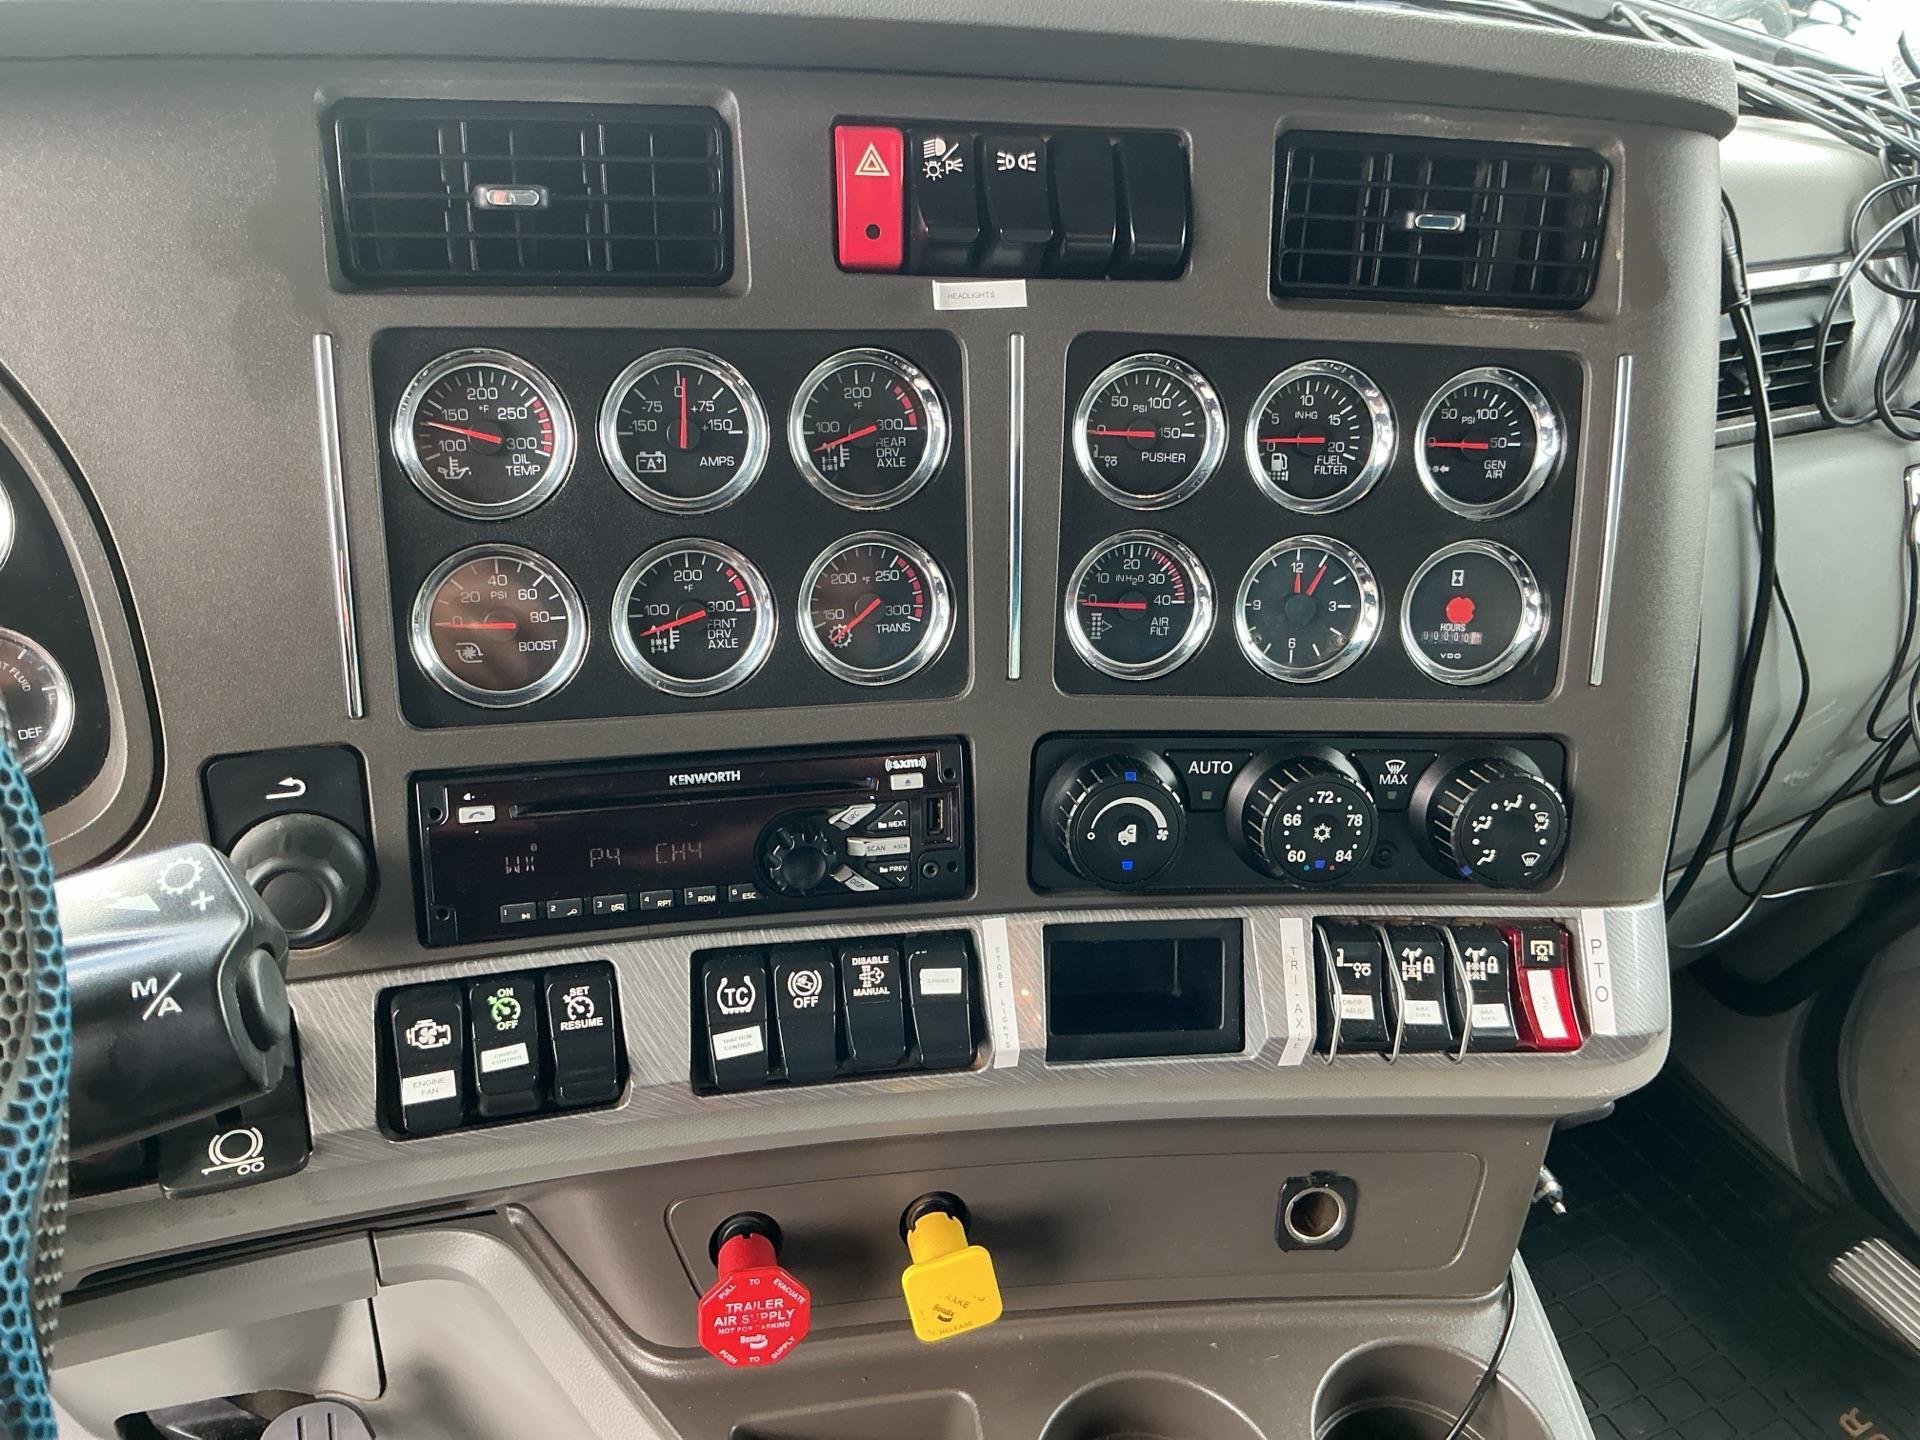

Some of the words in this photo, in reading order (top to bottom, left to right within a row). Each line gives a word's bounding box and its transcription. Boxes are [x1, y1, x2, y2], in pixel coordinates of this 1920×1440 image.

[948, 291, 995, 299] HEADLIGHTS
[467, 387, 498, 400] 200
[844, 387, 872, 399] 200
[1111, 396, 1129, 408] 50
[1148, 397, 1172, 409] 100
[1300, 394, 1314, 407] 10
[690, 400, 715, 413] +75
[1132, 404, 1148, 413] PSI
[442, 408, 469, 421] 150
[498, 407, 527, 420] 250
[1441, 409, 1457, 420] 50
[1476, 409, 1498, 420] 100
[702, 419, 733, 431] +150
[877, 418, 903, 431] 300
[1271, 414, 1280, 425] 5
[1328, 415, 1341, 426] 15
[1461, 416, 1476, 424] PSI
[816, 421, 840, 433] 100
[1160, 427, 1181, 439] 150
[439, 439, 466, 452] 100
[507, 437, 537, 450] 300
[876, 437, 906, 447] REAR
[1266, 441, 1276, 452] 0
[1328, 442, 1345, 453] 20
[1427, 437, 1437, 448] 0
[876, 448, 899, 459] DRV
[1141, 451, 1186, 463] PUSHER
[512, 454, 531, 465] OIL
[700, 456, 735, 467] AMPS
[877, 458, 907, 468] AXLE
[1316, 455, 1343, 465] FUEL
[1484, 460, 1506, 470] GEN
[505, 465, 541, 476] TEMP
[1313, 465, 1348, 475] FILTER
[1485, 469, 1503, 479] AIR
[1123, 559, 1140, 570] 20
[1291, 562, 1304, 573] 12
[488, 574, 508, 587] 40
[673, 569, 703, 582] 200
[830, 572, 857, 584] 200
[875, 570, 899, 582] 250
[1096, 573, 1109, 584] 10
[1148, 574, 1165, 585] 30
[460, 591, 481, 603] 20
[490, 591, 507, 600] PSI
[518, 588, 538, 601] 60
[1088, 593, 1097, 604] 0
[1153, 595, 1171, 606] 40
[1252, 600, 1262, 610] 9
[644, 604, 670, 616] 100
[707, 600, 736, 613] 300
[885, 604, 911, 616] 300
[1328, 601, 1337, 612] 3
[530, 611, 550, 623] 80
[824, 608, 845, 620] 150
[707, 618, 738, 629] FRNT
[876, 622, 911, 633] TRANS
[1150, 617, 1169, 627] AIR
[1440, 623, 1466, 632] HOURS
[707, 629, 732, 640] DRV
[1150, 627, 1170, 636] FILT
[518, 640, 558, 652] BOOST
[708, 638, 739, 649] AXLE
[1288, 638, 1296, 649] 6
[9, 667, 31, 692] FLUID
[18, 727, 43, 740] DEF
[1188, 761, 1233, 775] AUTO
[669, 770, 741, 786] KENWORTH
[1379, 774, 1408, 785] MAX
[1317, 791, 1334, 804] 72
[888, 820, 907, 828] NEXT
[1283, 814, 1302, 827] 66
[1346, 815, 1363, 827] 78
[867, 844, 886, 852] SCAN
[590, 848, 621, 868] P4
[656, 842, 702, 864] CH4
[1287, 850, 1306, 863] 60
[1335, 850, 1352, 862] 84
[697, 895, 716, 903] RDM
[742, 892, 757, 900] ESC
[657, 899, 673, 908] RPT
[851, 955, 890, 966] DISABLE
[497, 987, 514, 997] ON
[569, 986, 589, 996] SET
[853, 986, 891, 997] MANUAL
[724, 988, 749, 1006] TC
[793, 996, 819, 1009] OFF
[497, 1020, 518, 1031] OFF
[560, 1016, 604, 1031] RESUME
[722, 1034, 752, 1044] TRACTION
[724, 1041, 753, 1051] CONTROL
[412, 1077, 447, 1089] ENGINE
[421, 1087, 439, 1096] FAN
[718, 1284, 737, 1300] PULL
[772, 1278, 806, 1304] EVACUATE
[726, 1298, 784, 1313] TRAILER
[714, 1315, 737, 1327] AIR
[718, 1327, 735, 1335] NOT
[740, 1334, 767, 1344] Bendix
[719, 1349, 738, 1364] PUSH
[771, 1336, 796, 1359] SUPPLY
